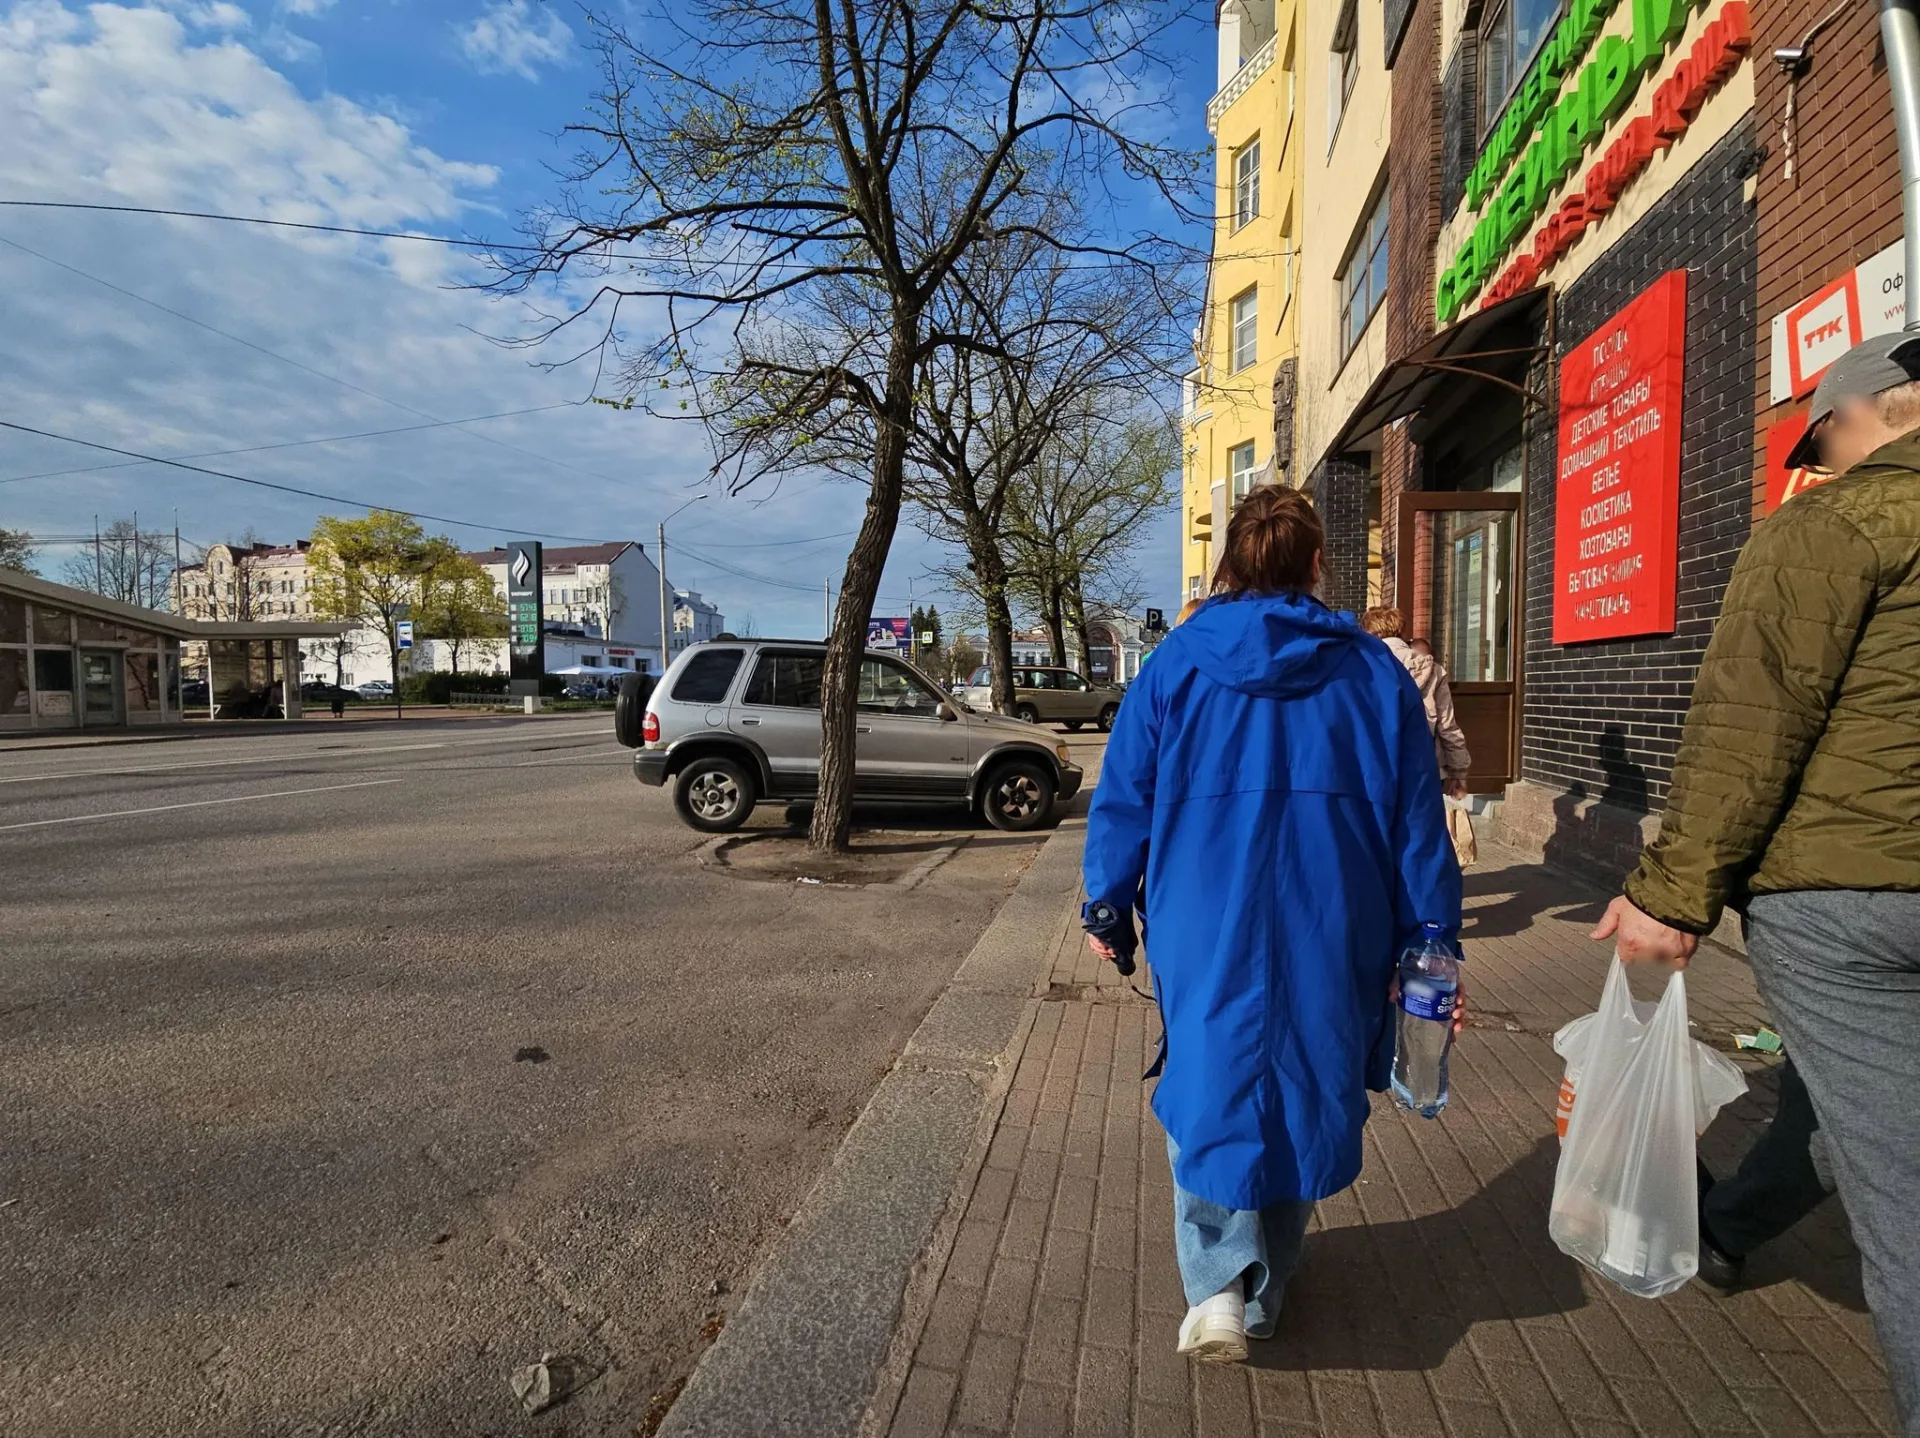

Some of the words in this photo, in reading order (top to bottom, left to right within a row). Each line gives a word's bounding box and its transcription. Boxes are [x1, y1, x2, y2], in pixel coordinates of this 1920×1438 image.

[1465, 0, 1603, 212] УНИВЕРМ
[1583, 116, 1652, 216] ДЛЯ
[1651, 1, 1747, 140] ДОМА
[1804, 314, 1843, 350] ТТК
[1571, 404, 1608, 449] ДЕТСКИЕ
[1612, 375, 1651, 419] ТОВАРЫ
[1561, 430, 1609, 481] ДОМАШНИЙ
[1613, 407, 1661, 451] ТЕКСТИЛЬ
[1592, 461, 1620, 494] БЕЛЬЕ
[1580, 490, 1632, 530] КОСМЕТИКА
[1579, 523, 1632, 560] ХОЗТОВАРЫ
